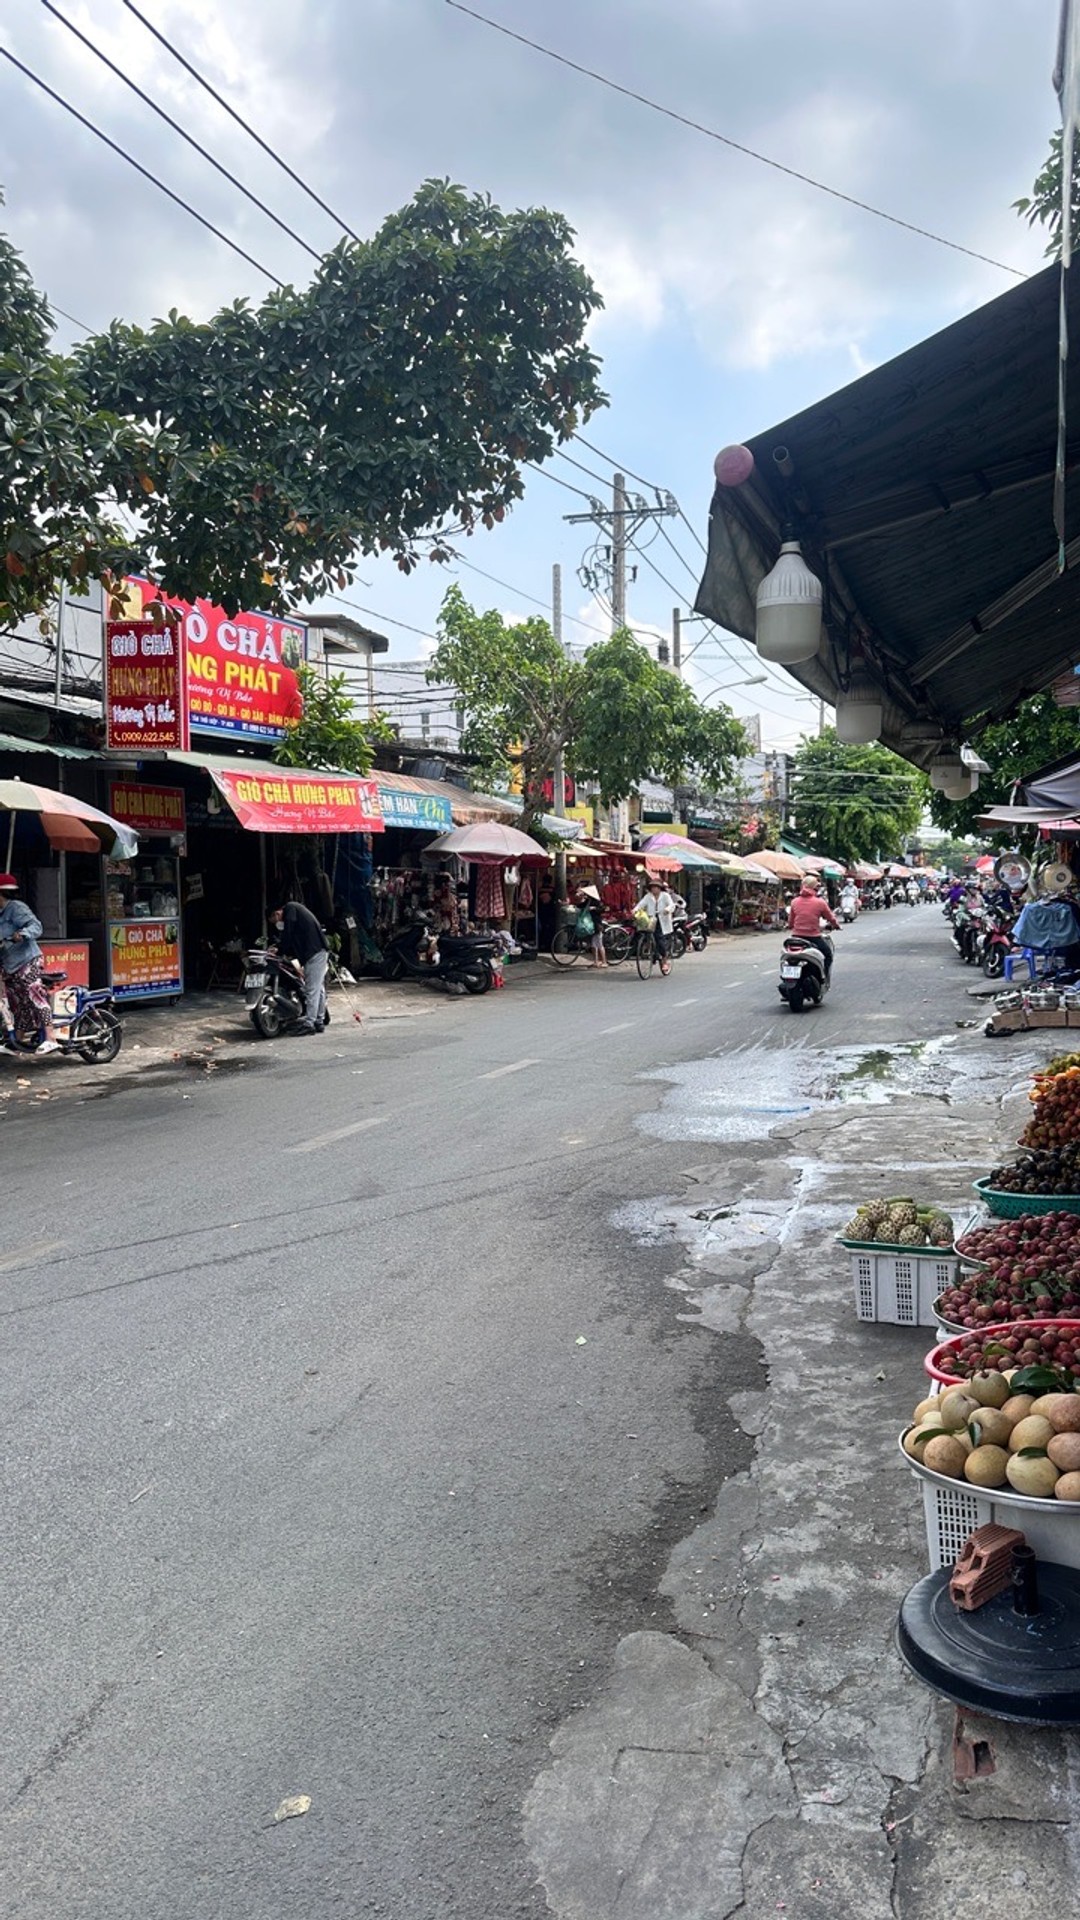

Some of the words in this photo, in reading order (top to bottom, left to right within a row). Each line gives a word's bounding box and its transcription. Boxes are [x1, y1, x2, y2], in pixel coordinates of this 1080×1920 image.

[111, 630, 138, 656] GIÒ
[141, 627, 174, 656] CHẢ
[217, 619, 280, 664] CHẢ
[187, 651, 218, 682] NG
[225, 663, 281, 695] PHÁT
[121, 731, 175, 742] 0909.622.545
[236, 778, 261, 801] GIÒ
[263, 778, 290, 804] CHẢ
[329, 780, 357, 806] PHÁT
[128, 926, 144, 943] GIÒ
[145, 924, 163, 942] CHẢ
